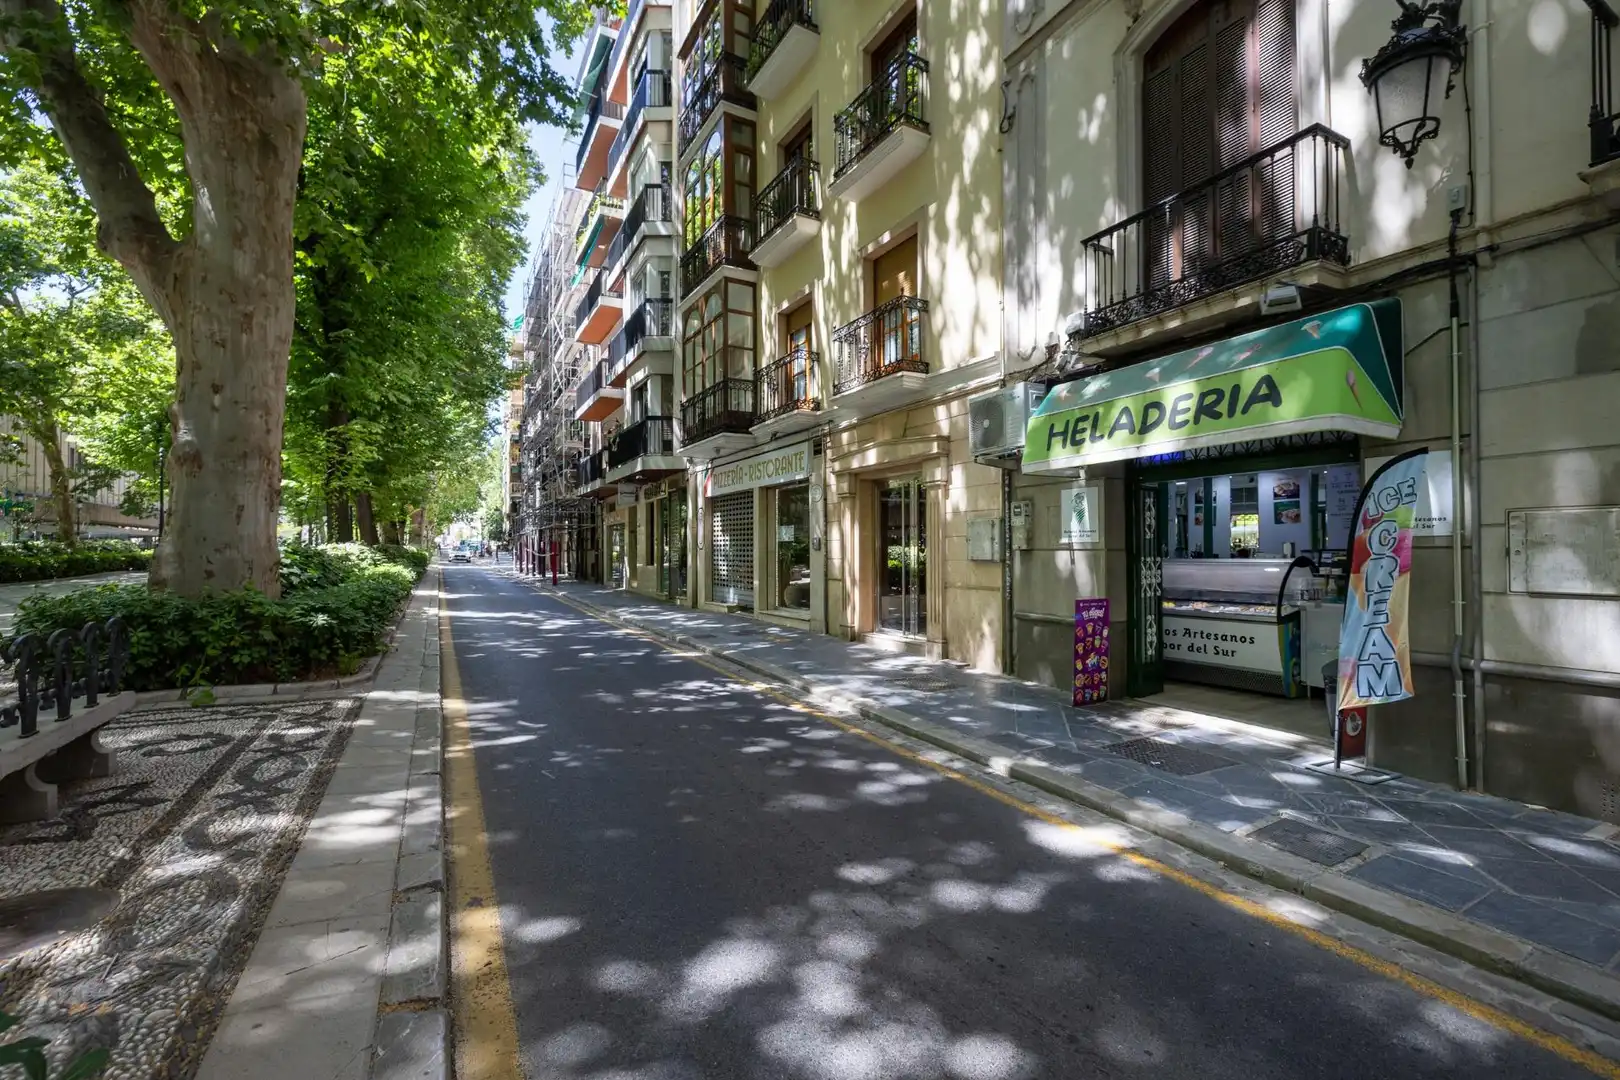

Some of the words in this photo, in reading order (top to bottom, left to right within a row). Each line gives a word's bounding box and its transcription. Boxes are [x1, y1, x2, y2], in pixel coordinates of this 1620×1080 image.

[1047, 374, 1282, 451] HELADERIA
[713, 464, 744, 490] PIZZERÍA
[748, 451, 805, 482] RISTORANTE
[1366, 476, 1417, 517] ICE
[1356, 519, 1402, 698] CREAM
[1182, 627, 1256, 645] Artesanos
[1187, 642, 1208, 655] del
[1213, 645, 1237, 657] Sur
